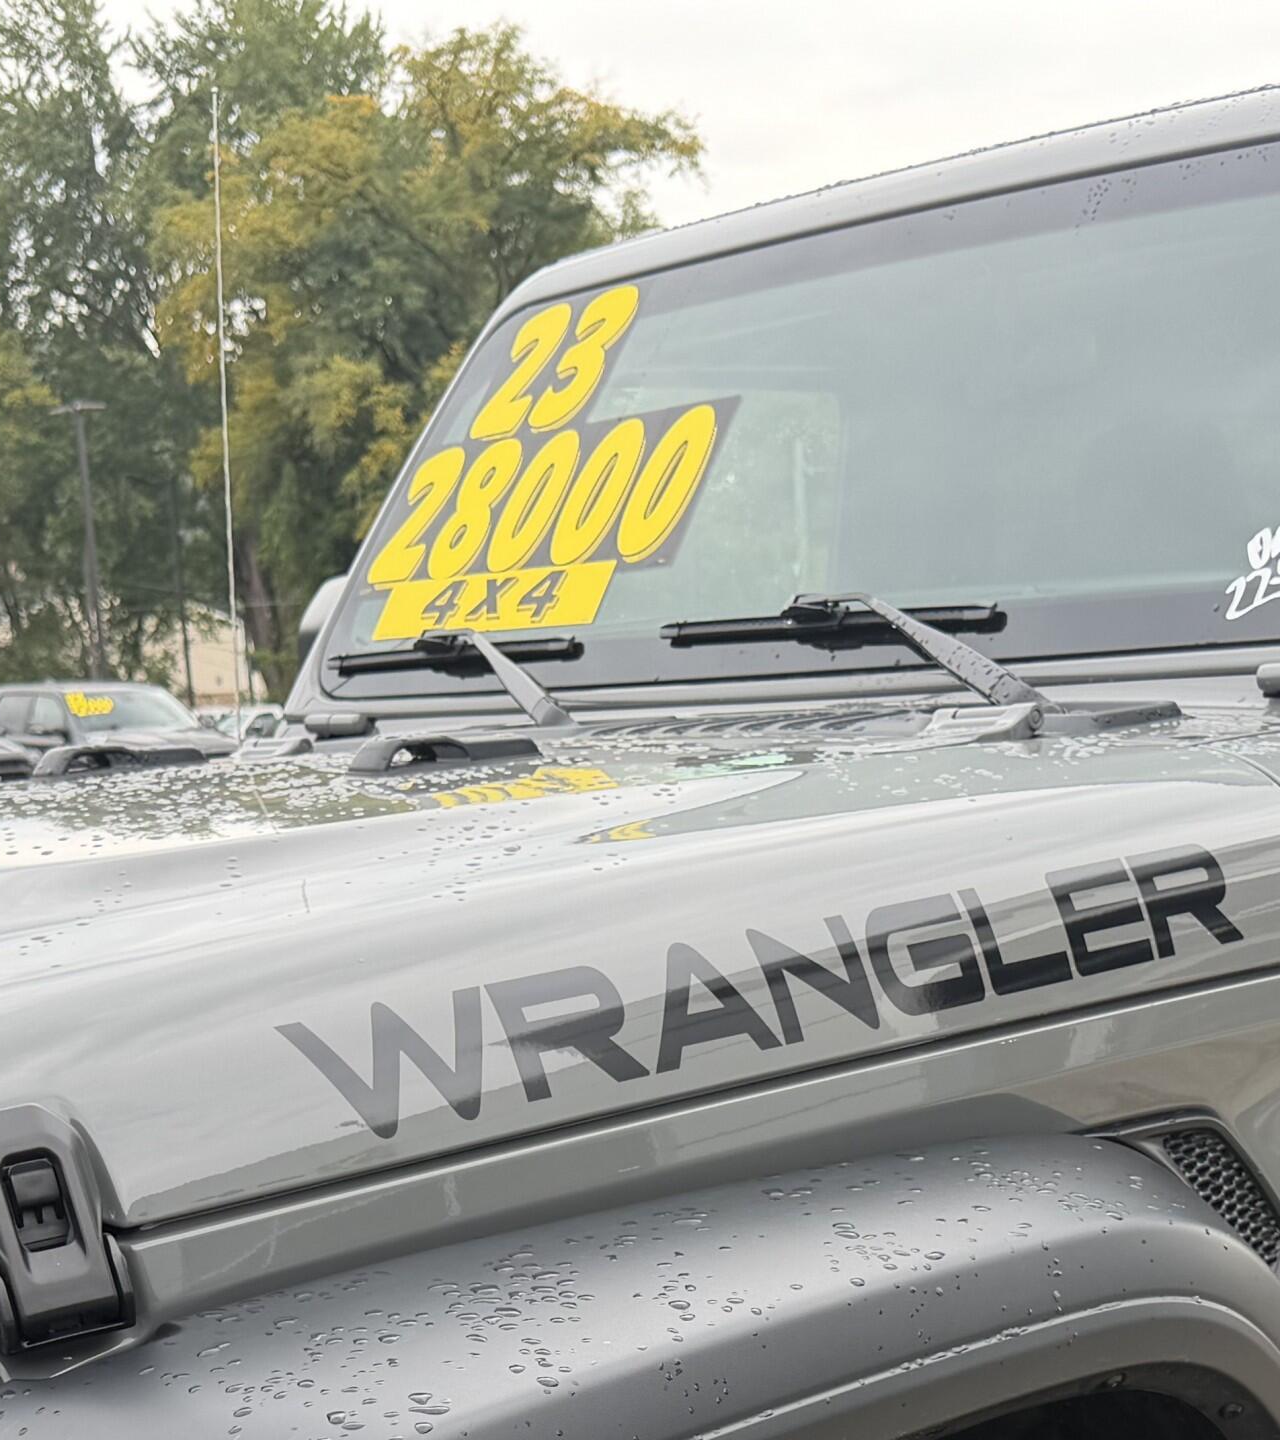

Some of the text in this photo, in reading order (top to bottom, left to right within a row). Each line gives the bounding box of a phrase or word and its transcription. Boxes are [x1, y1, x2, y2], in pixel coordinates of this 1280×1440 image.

[470, 285, 639, 441] 23
[367, 404, 718, 591] 28000
[276, 843, 1244, 1140] WRANGLER
